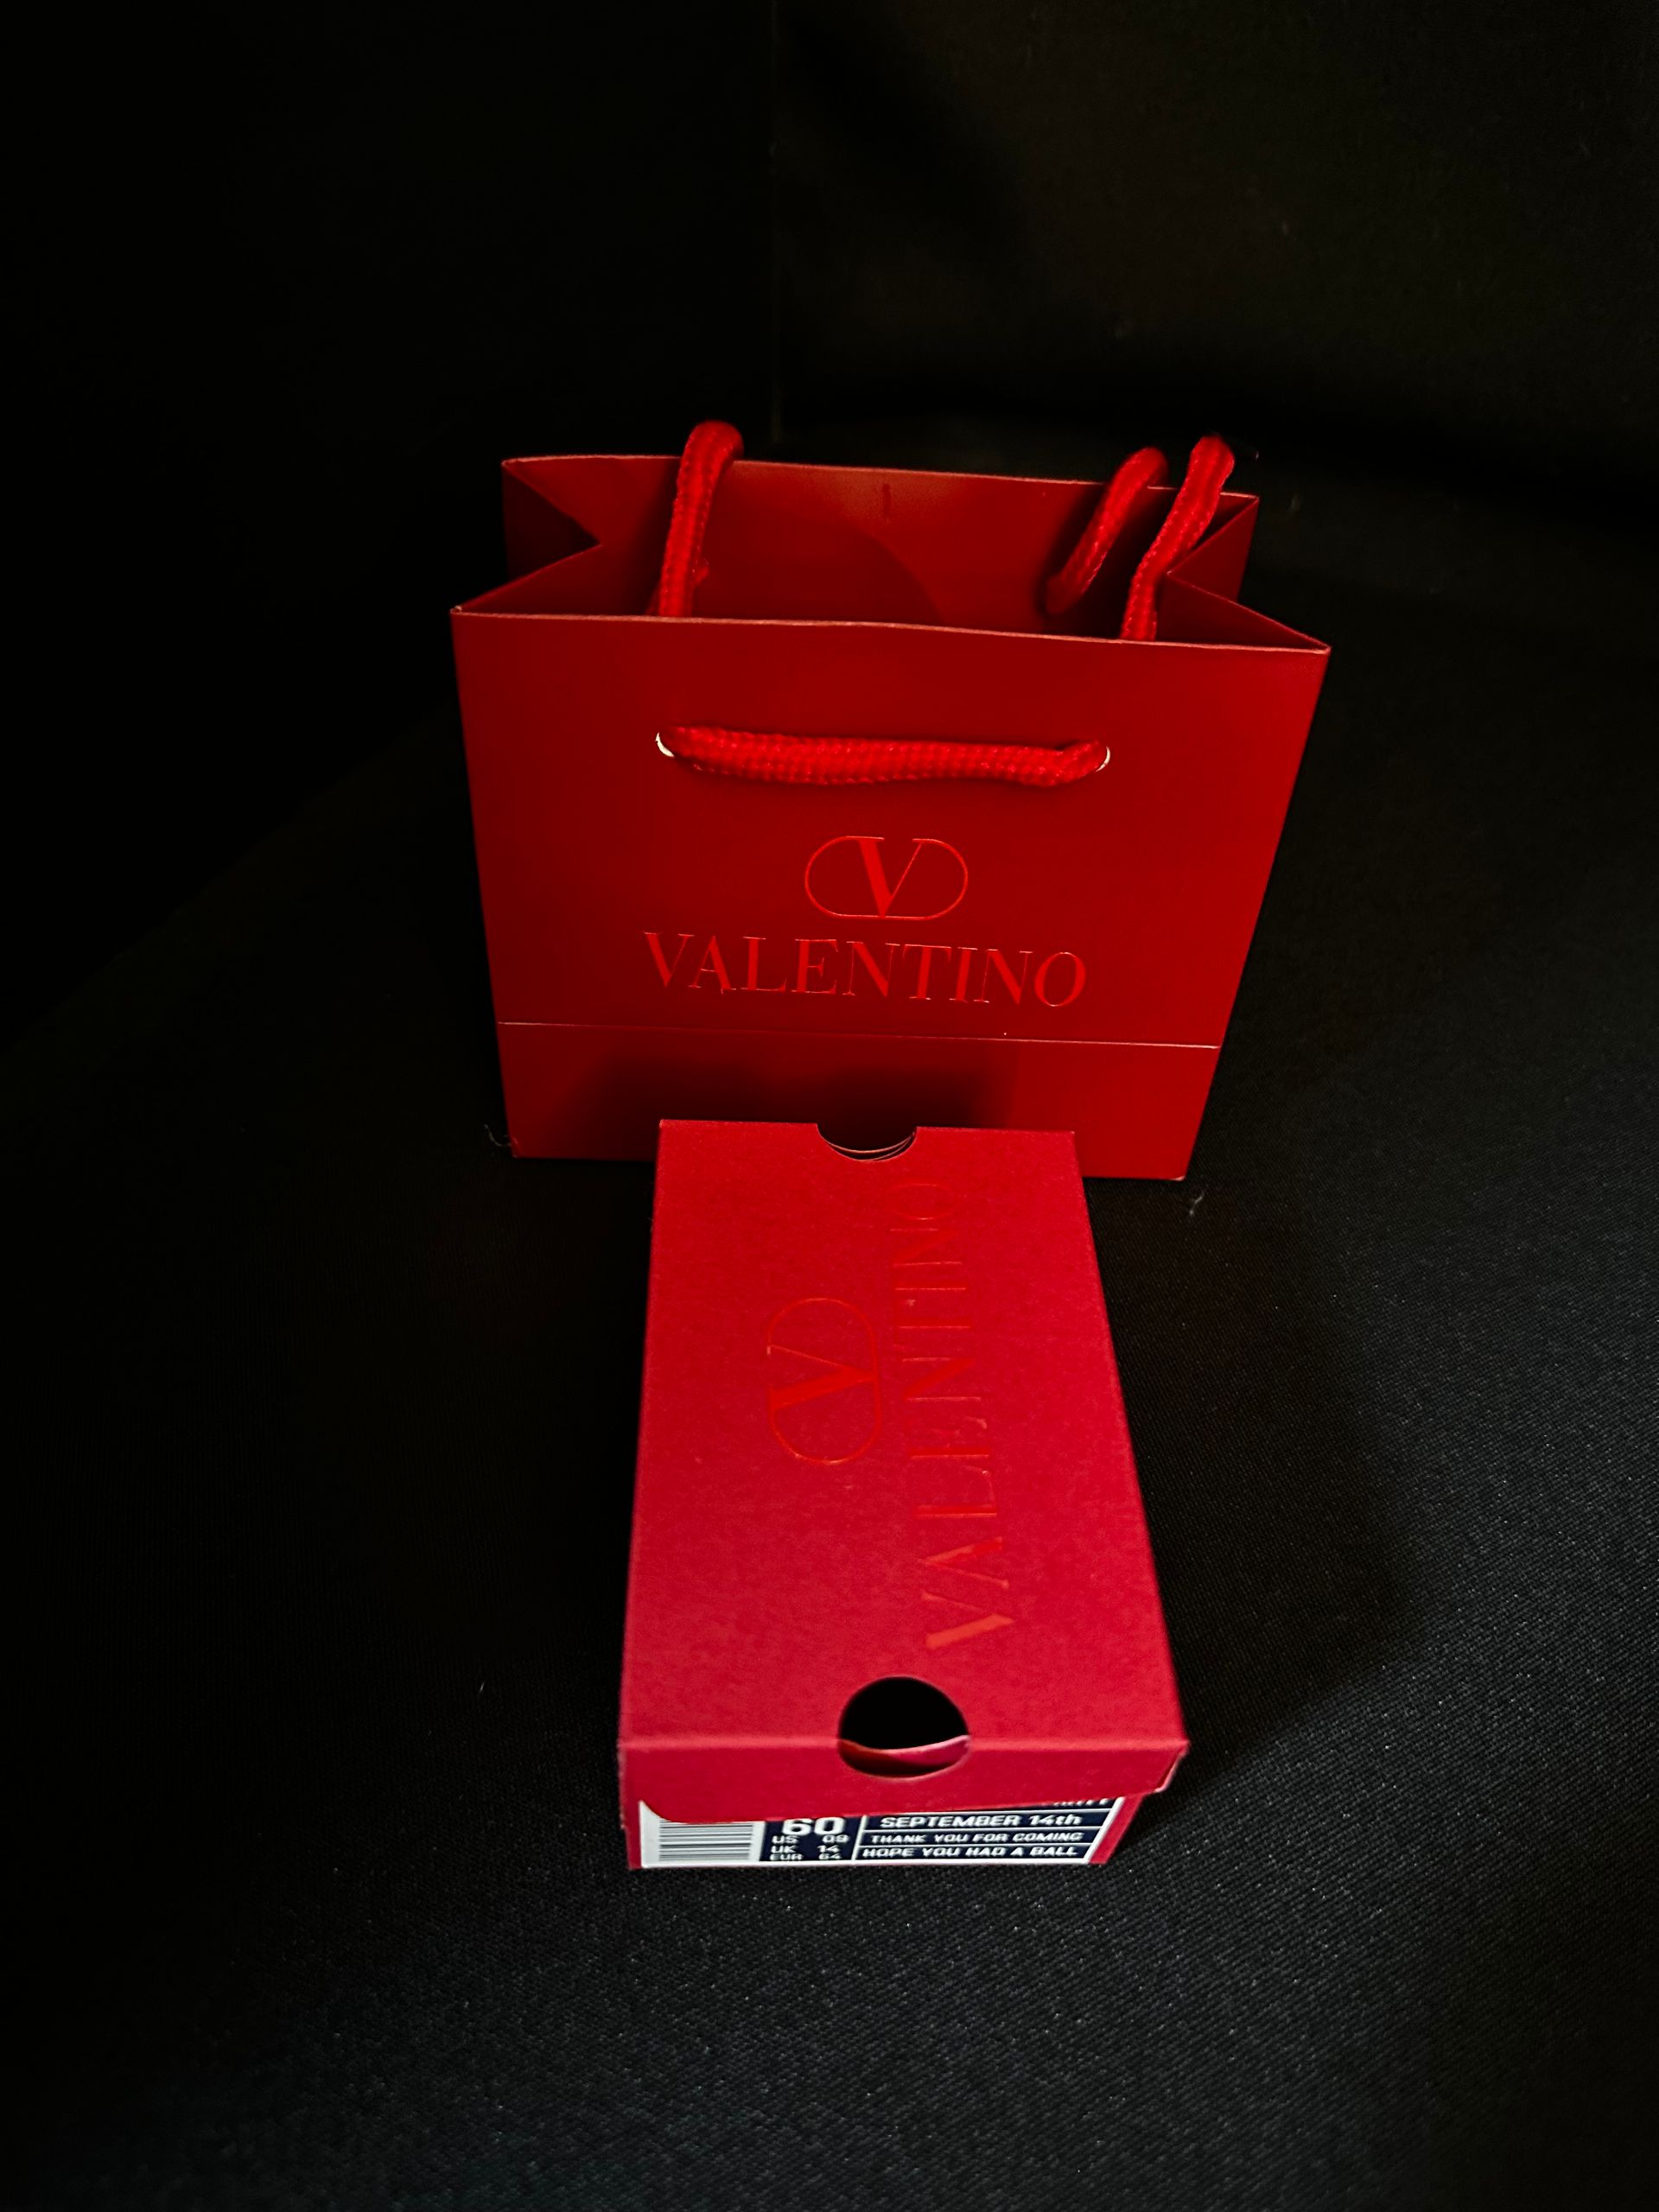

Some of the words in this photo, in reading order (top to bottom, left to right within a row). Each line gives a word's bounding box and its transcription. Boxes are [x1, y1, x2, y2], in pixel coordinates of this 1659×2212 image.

[643, 931, 1087, 1007] VALENTINO
[884, 1179, 1014, 1650] VALENTINO
[782, 1816, 846, 1835] 60
[880, 1815, 1021, 1828] SEPTEMBER
[1029, 1814, 1083, 1826] 14th
[772, 1835, 799, 1844] US
[870, 1834, 927, 1843] THANK
[933, 1834, 969, 1843] YOU
[972, 1833, 1009, 1842] FOR
[1012, 1832, 1085, 1842] COMING
[771, 1845, 797, 1853] UK
[862, 1847, 916, 1858] HOPE
[921, 1847, 961, 1857] YOU
[965, 1847, 1007, 1857] HAD
[1010, 1847, 1024, 1857] A
[1029, 1846, 1078, 1856] BALL
